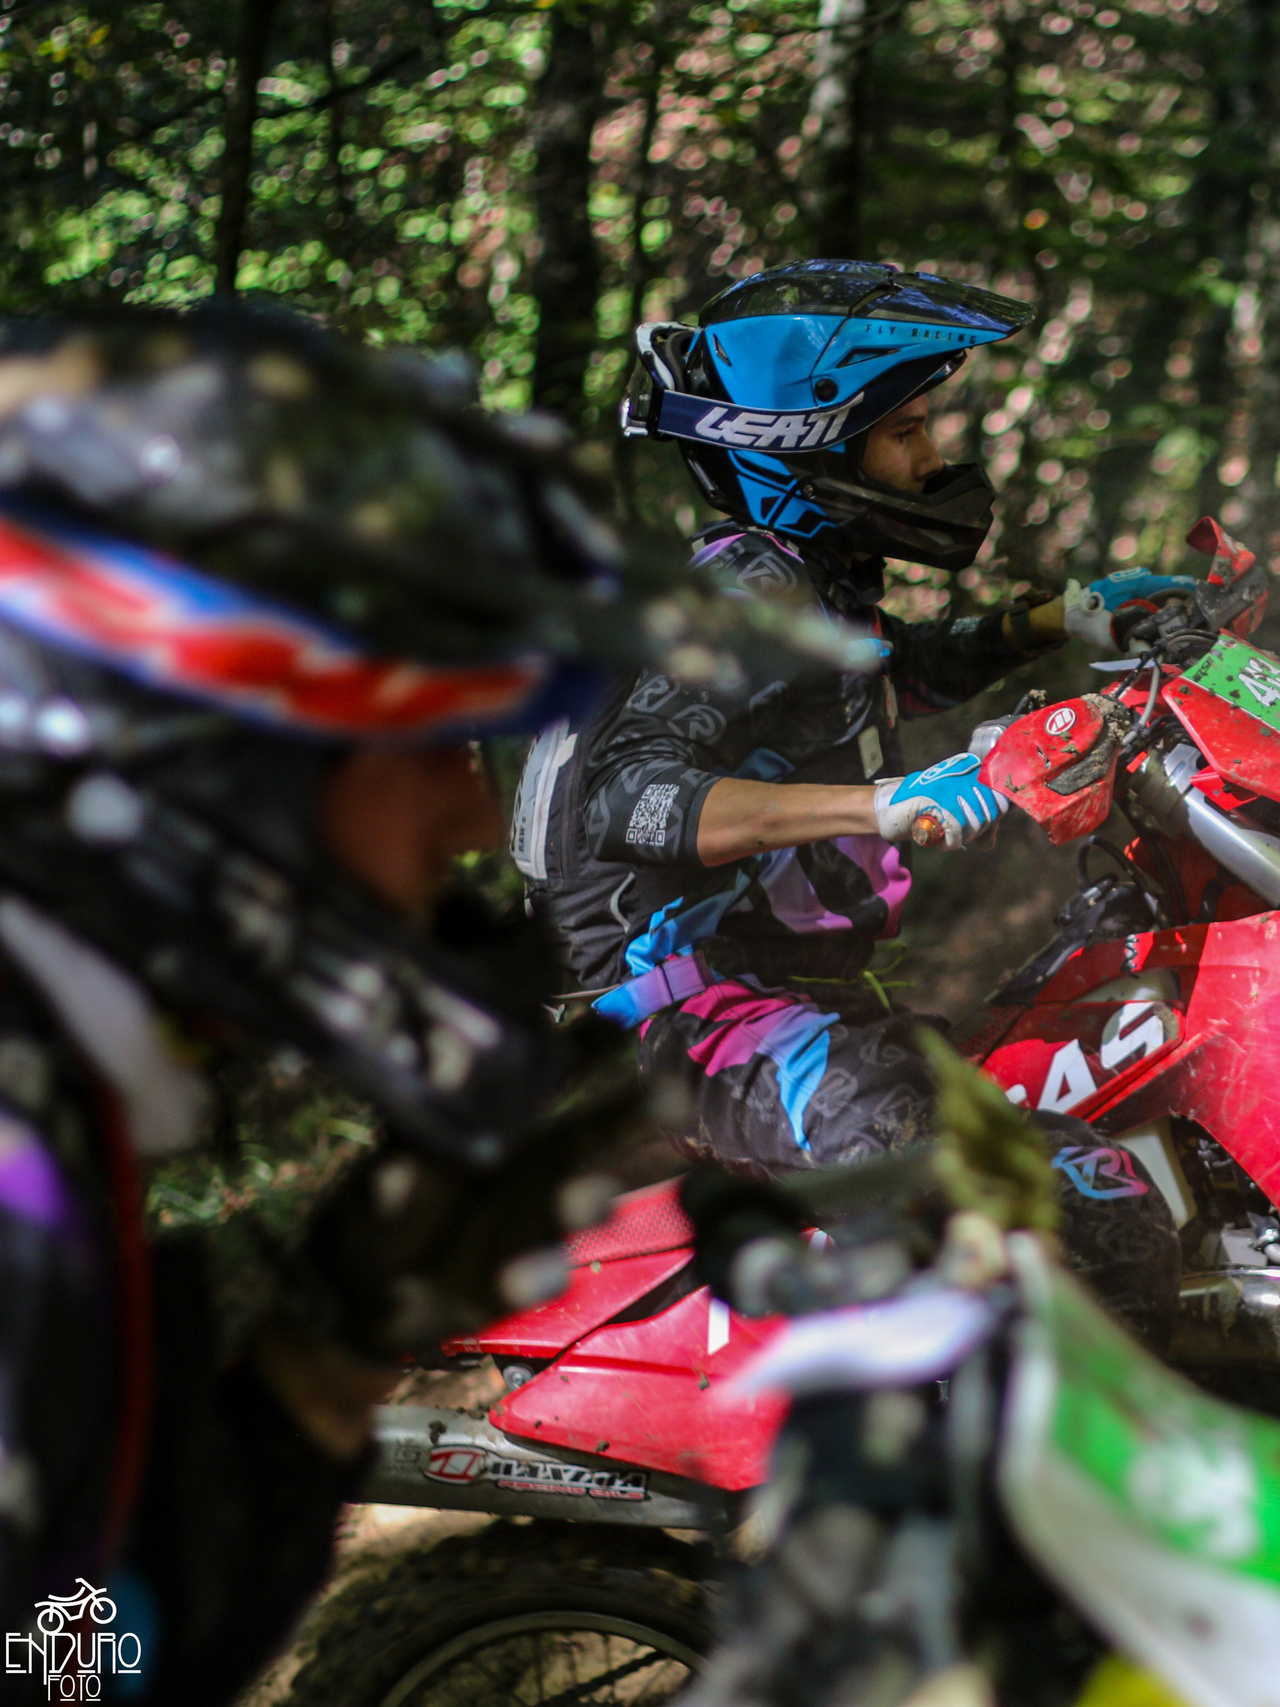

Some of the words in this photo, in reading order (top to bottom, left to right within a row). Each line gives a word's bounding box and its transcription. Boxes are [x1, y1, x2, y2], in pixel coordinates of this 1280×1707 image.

[866, 323, 896, 335] FLY
[911, 328, 977, 345] RACING
[1005, 1001, 1178, 1114] AS
